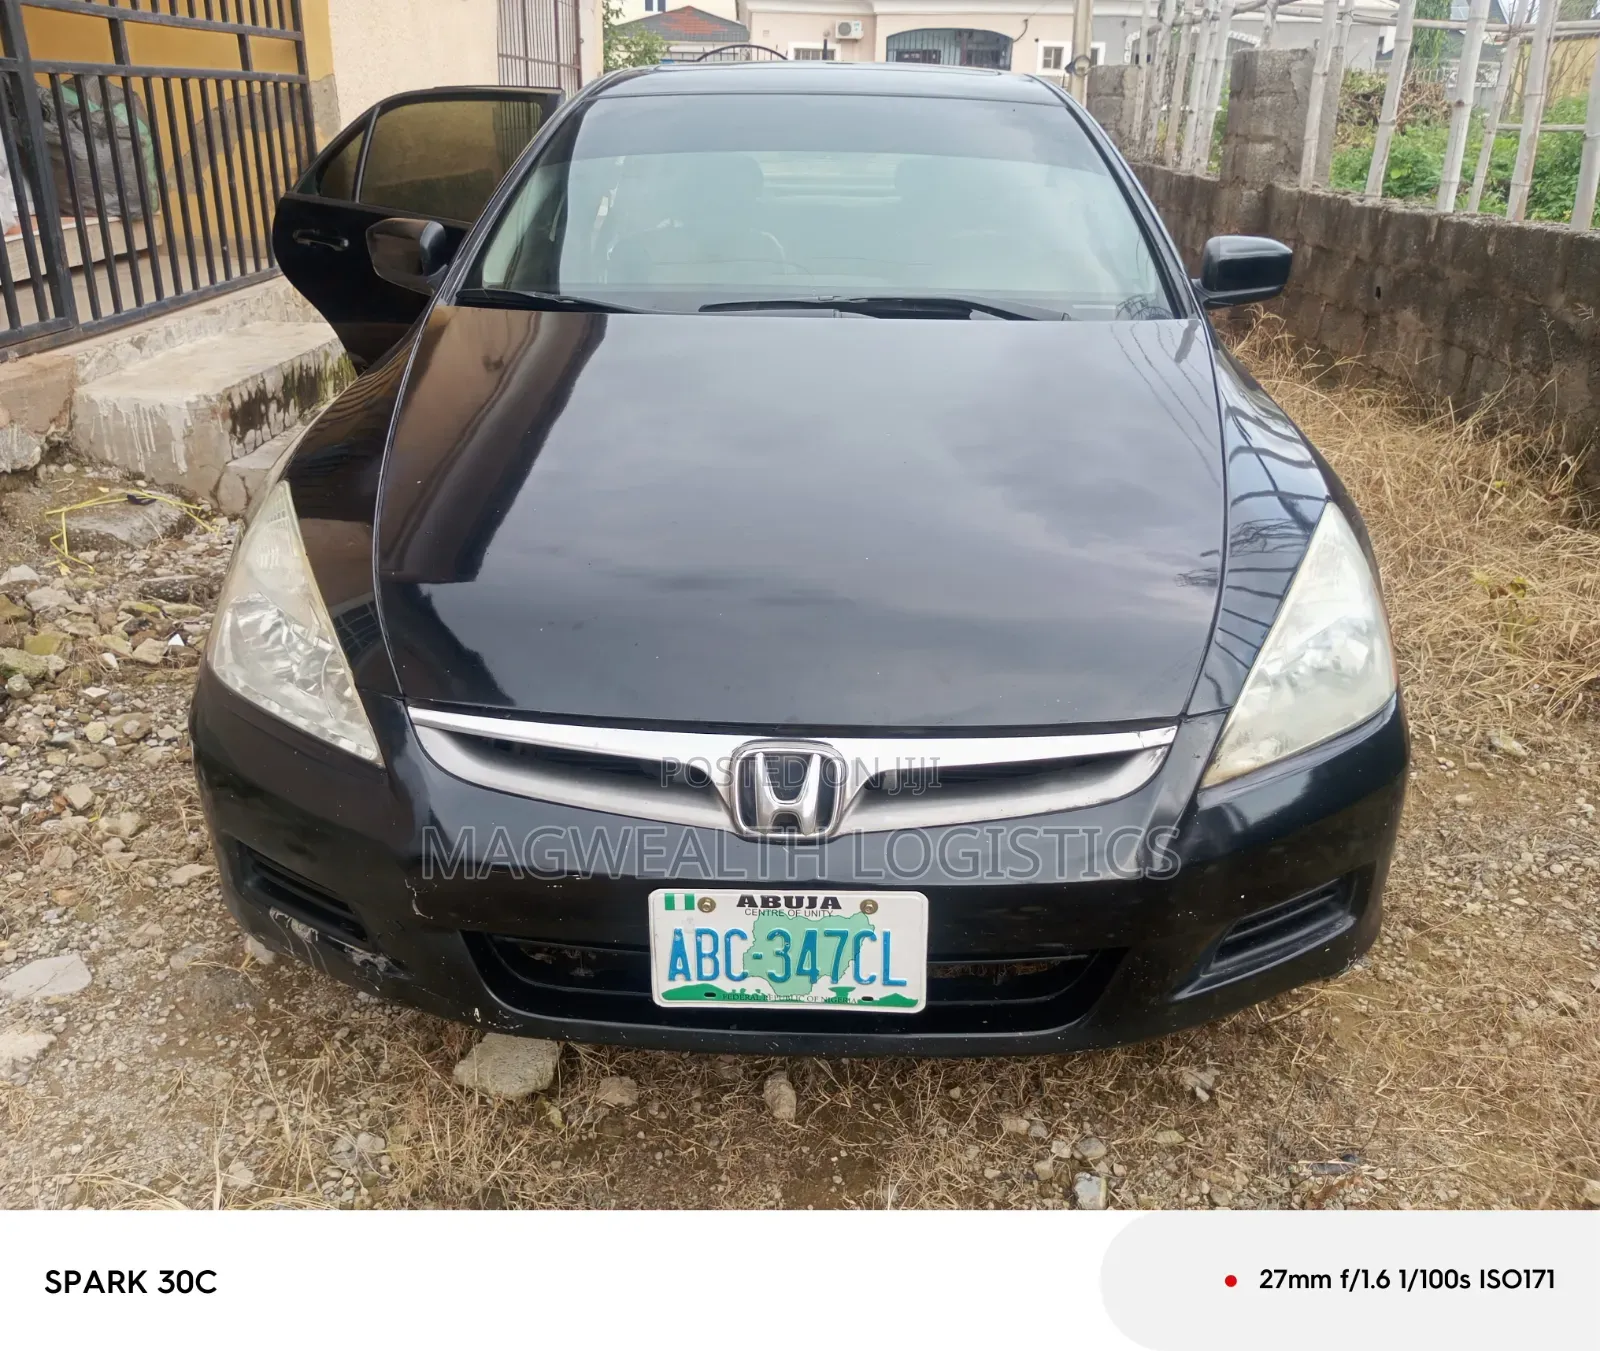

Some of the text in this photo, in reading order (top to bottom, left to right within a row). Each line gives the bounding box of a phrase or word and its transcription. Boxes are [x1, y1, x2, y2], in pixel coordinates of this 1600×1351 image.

[736, 893, 842, 910] ABUJA
[744, 908, 834, 918] CENTRE OF UNITY
[668, 928, 907, 986] ABC-347CL
[722, 993, 762, 1001] FEDERAL
[763, 993, 804, 1002] REPUBLIC
[820, 996, 857, 1004] NIGERIA
